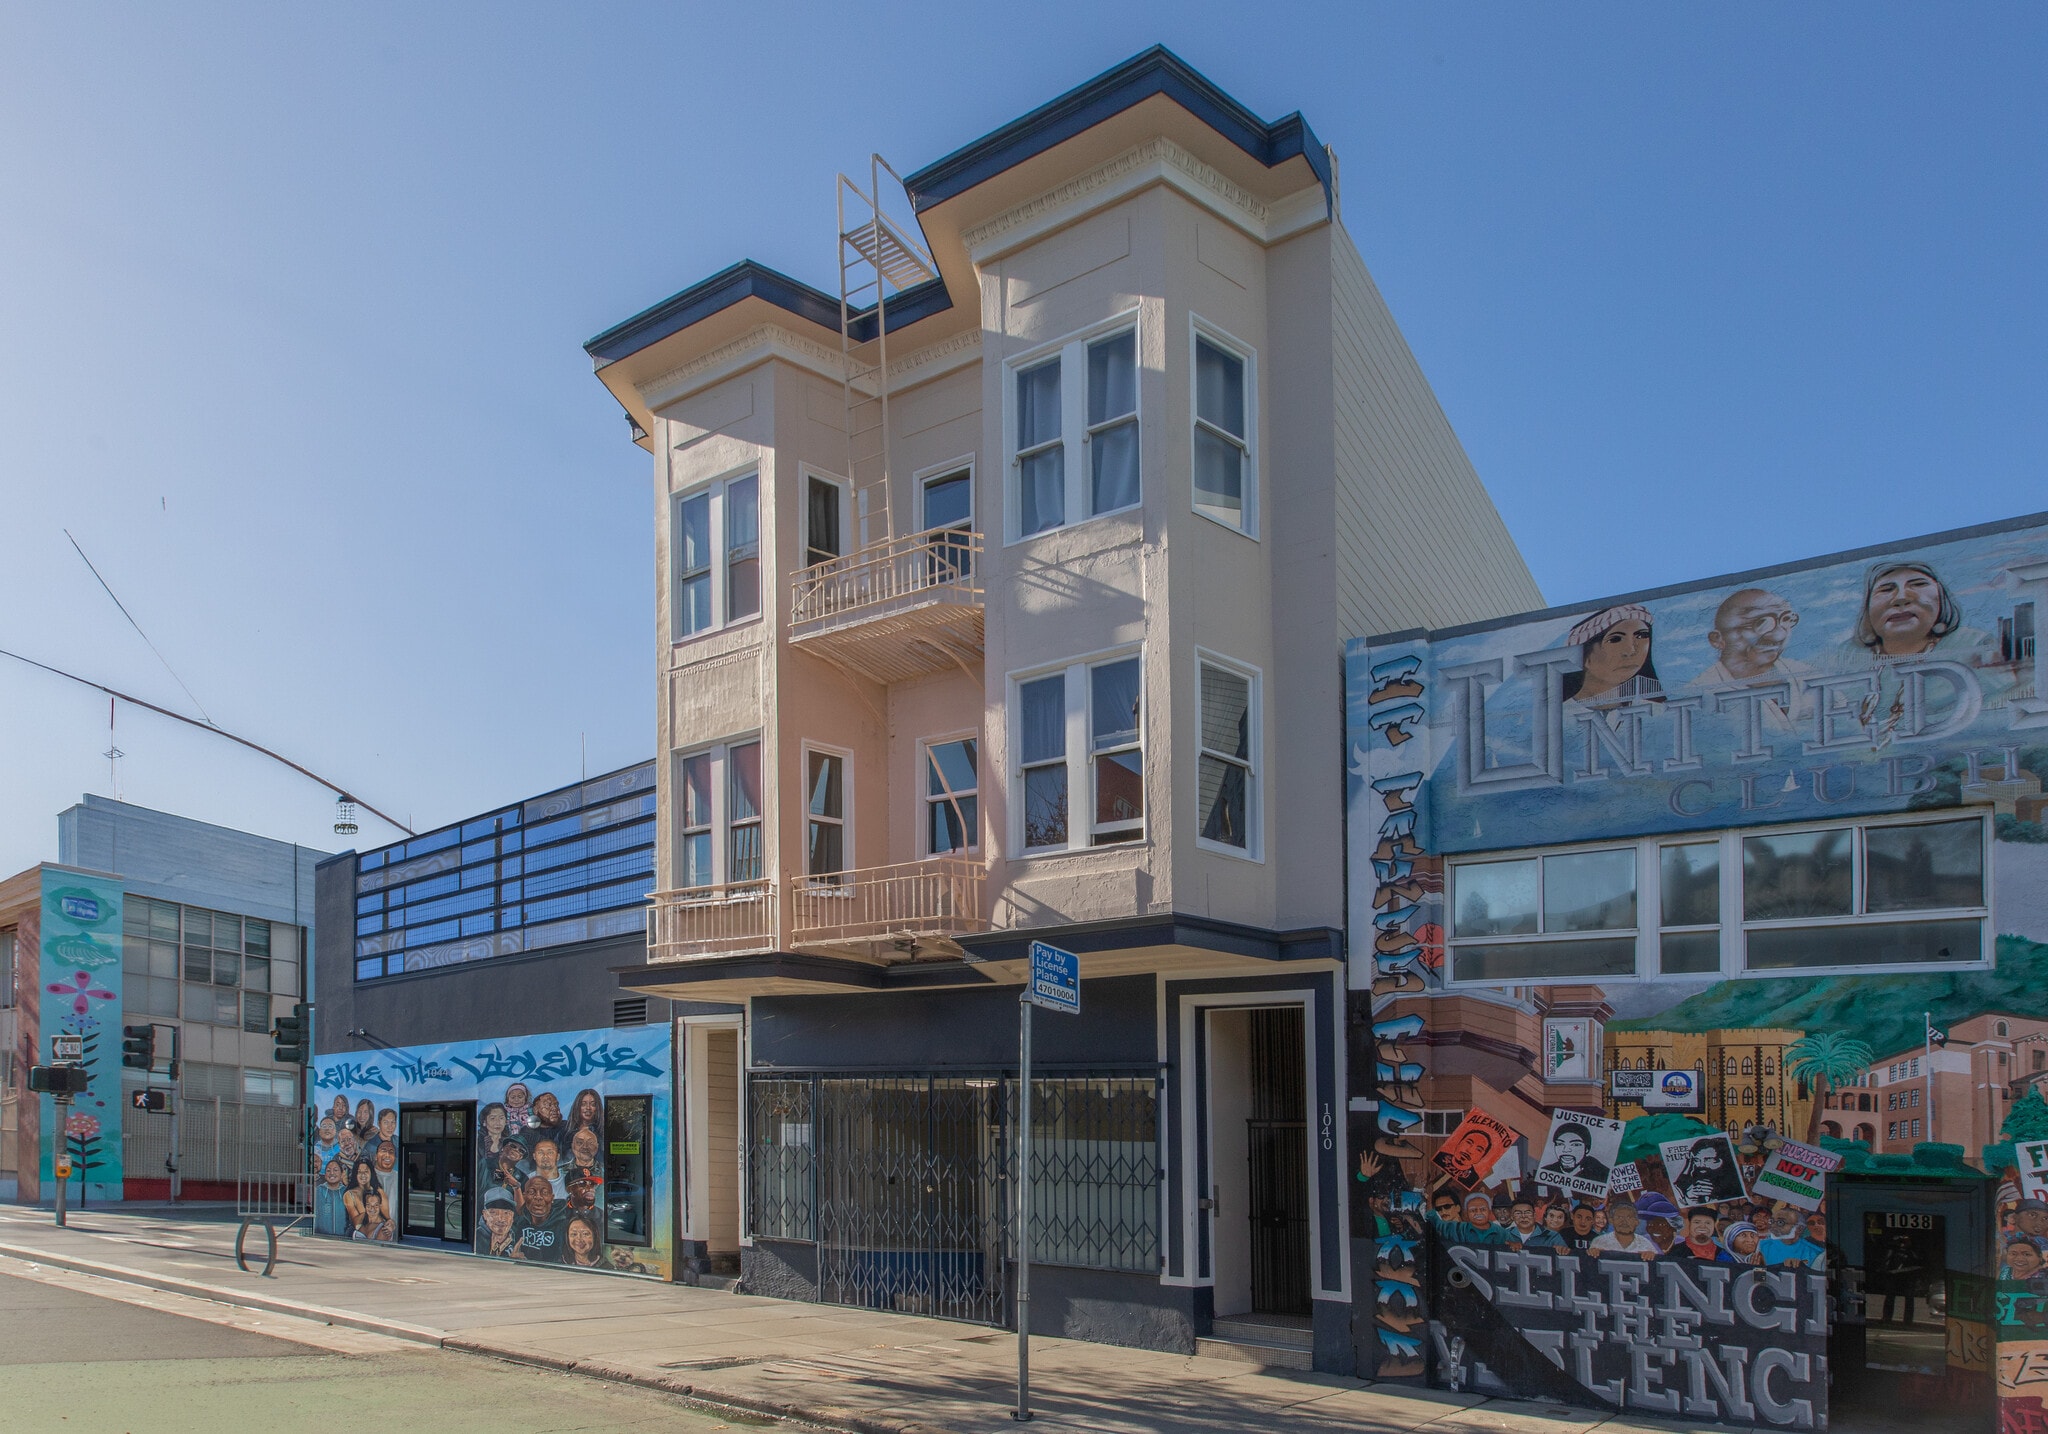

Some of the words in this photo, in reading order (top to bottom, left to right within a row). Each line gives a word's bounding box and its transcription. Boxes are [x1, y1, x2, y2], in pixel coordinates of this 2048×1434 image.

[1438, 644, 1985, 795] UNITED
[1036, 945, 1053, 960] Pay
[1054, 951, 1066, 965] by
[1036, 956, 1068, 976] License
[1036, 968, 1059, 983] Plate
[1038, 984, 1074, 1001] 47010004
[427, 1068, 448, 1078] 1044
[1321, 1103, 1332, 1150] 1040
[1555, 1110, 1605, 1129] JUSTICE
[1609, 1122, 1620, 1132] 4
[1466, 1115, 1494, 1132] ALEX
[1492, 1122, 1512, 1148] NIETO
[1667, 1145, 1689, 1154] FREE
[1776, 1159, 1820, 1182] NOT
[1539, 1171, 1572, 1187] OSCAR
[1572, 1180, 1607, 1195] GRANT
[1613, 1181, 1642, 1192] PEOPLE
[1888, 1213, 1931, 1228] 1038
[1572, 1300, 1702, 1349] THE
